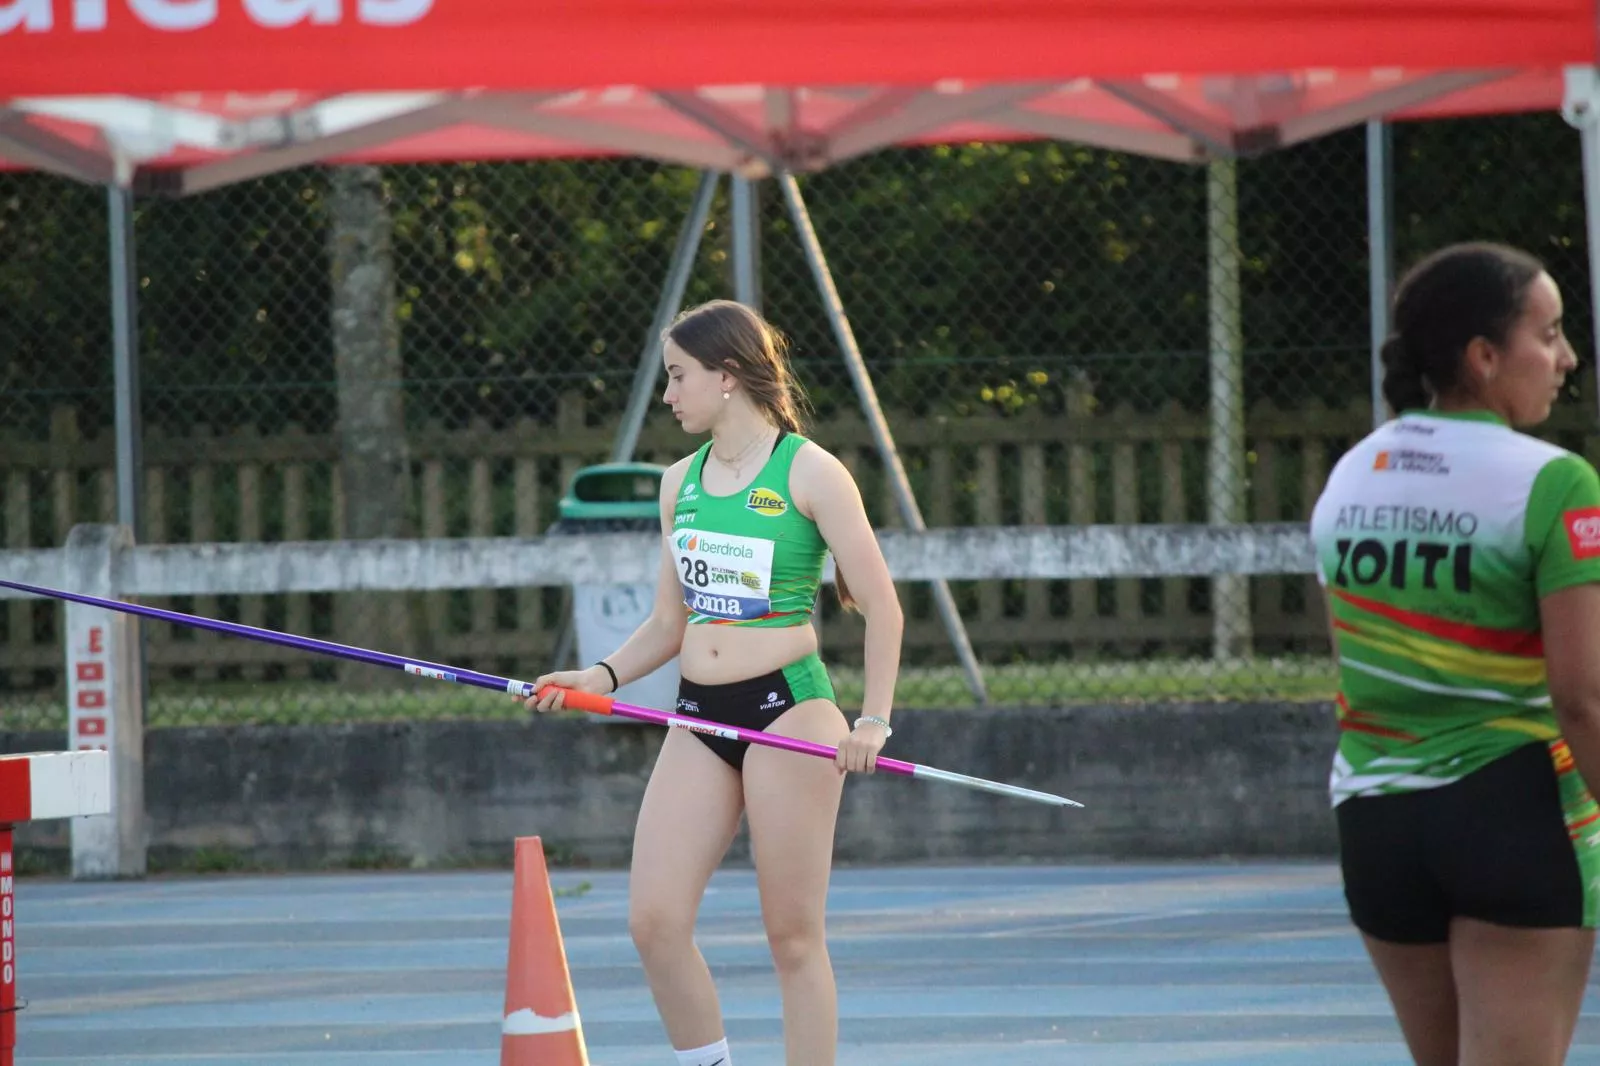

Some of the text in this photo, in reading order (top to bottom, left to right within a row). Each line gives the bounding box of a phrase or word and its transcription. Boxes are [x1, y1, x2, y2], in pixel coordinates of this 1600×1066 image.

[749, 490, 786, 510] intec
[1335, 506, 1478, 538] ATLETISMO
[700, 539, 753, 559] Iberdrola
[681, 557, 709, 588] 28
[1336, 538, 1471, 593] ZOITI
[76, 627, 107, 751] 000m
[759, 699, 786, 710] VIATOR
[1, 876, 14, 984] MONDO
